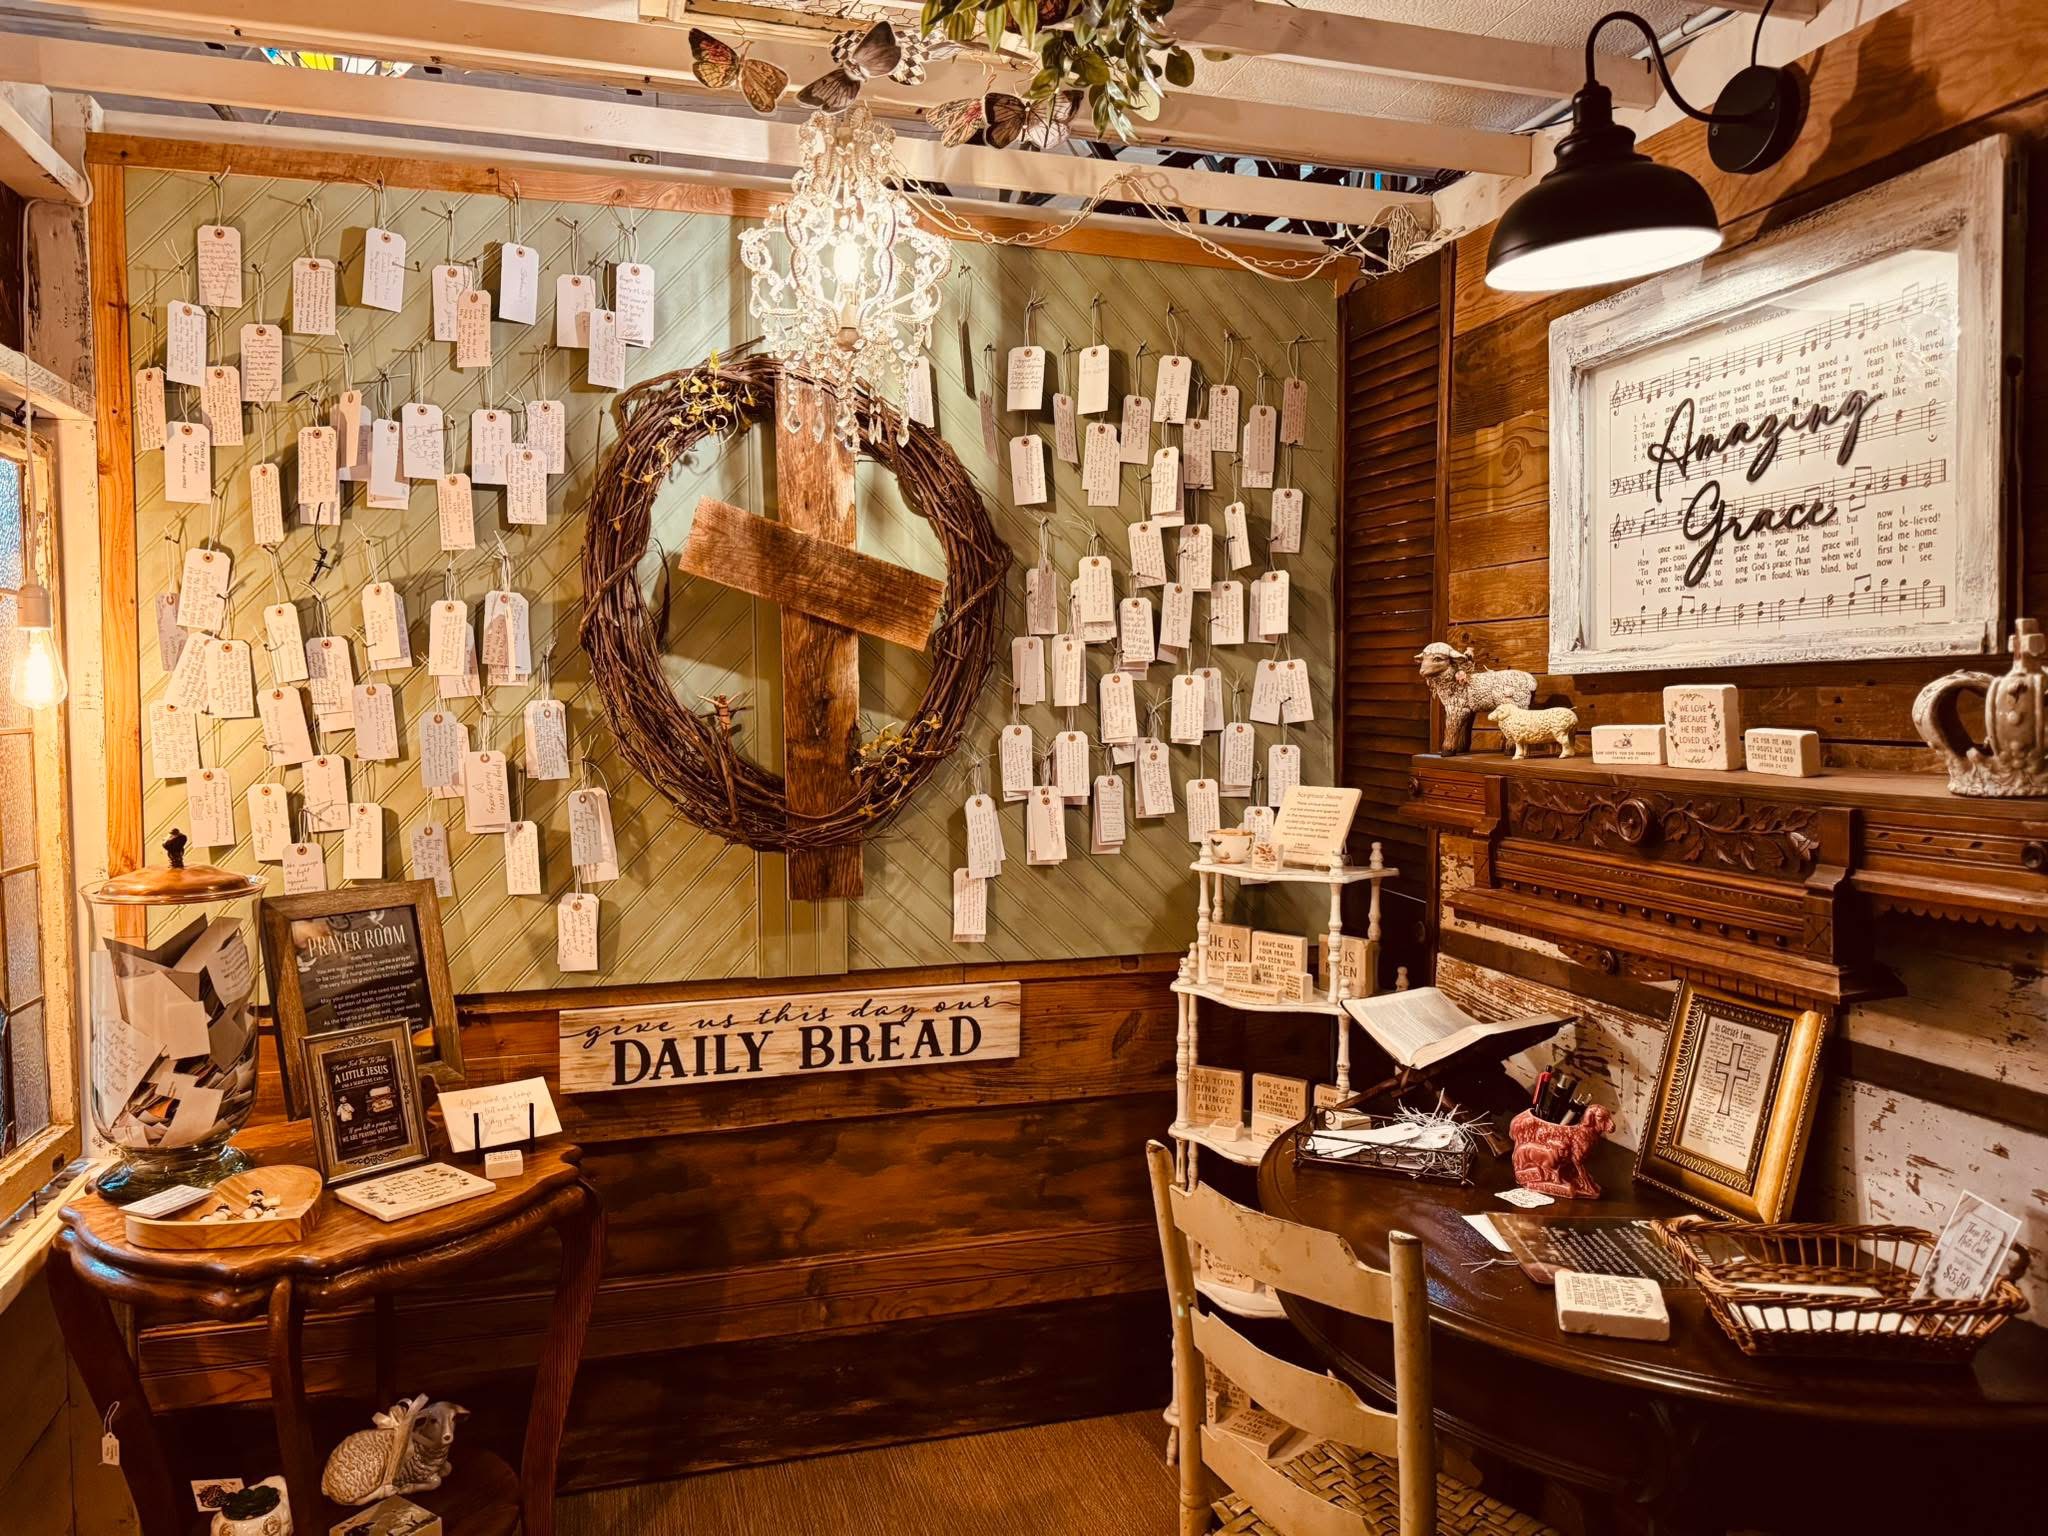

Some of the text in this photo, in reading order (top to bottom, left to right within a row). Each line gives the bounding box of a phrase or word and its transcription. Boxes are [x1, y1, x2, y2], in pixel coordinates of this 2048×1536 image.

[1718, 337, 1908, 398] how sweet the That saved wretch like
[1720, 400, 1730, 410] my
[1734, 395, 1750, 405] heart
[1797, 377, 1810, 386] And
[1818, 370, 1837, 383] grace
[1840, 365, 1852, 376] my
[1866, 356, 1885, 367] fears
[1892, 378, 1941, 397] like me!
[1893, 374, 1906, 384] the
[1735, 406, 1749, 415] toils
[1754, 400, 1766, 409] and
[1769, 395, 1789, 406] snares
[1819, 382, 1836, 392] have
[1647, 390, 1882, 504] Amazing
[1846, 515, 1858, 524] but
[1877, 510, 1892, 518] now
[1682, 480, 1838, 588] Grace
[1733, 544, 1750, 554] grace
[1775, 537, 1789, 547] pear
[1797, 534, 1809, 542] The
[1822, 530, 1839, 539] hour
[1877, 521, 1892, 531] first
[1657, 566, 1672, 576] grace
[1735, 555, 1748, 563] safe
[1796, 545, 1810, 554] And
[1822, 541, 1840, 552] grace
[1845, 538, 1859, 547] will
[1877, 534, 1893, 543] lead
[1635, 578, 1652, 586] We've
[1735, 566, 1748, 574] sing
[1752, 561, 1770, 571] God's
[1772, 561, 1792, 570] praise
[1822, 553, 1840, 562] when
[1843, 550, 1862, 559] we'd
[1877, 546, 1892, 555] first
[1755, 574, 1766, 582] I'm
[1796, 568, 1810, 576] Was
[1877, 558, 1893, 567] now
[308, 924, 406, 958] PRAYER ROOM
[1210, 934, 1240, 950] HE IS
[1274, 950, 1293, 958] PRAYER
[1345, 951, 1355, 963] IS
[560, 996, 1020, 1049] give us this day our
[1715, 1023, 1739, 1038] In Christ
[610, 1015, 981, 1086] DAILY BREAD
[335, 1065, 388, 1084] A LITTLE JESUS
[1212, 1078, 1235, 1086] YOUR
[1194, 1084, 1218, 1093] MIND
[1283, 1085, 1299, 1094] ABLE
[1198, 1094, 1232, 1104] THINGS
[1258, 1099, 1298, 1110] ABUNDANTLY
[1198, 1104, 1230, 1113] ABOVE
[1259, 1105, 1283, 1113] BEYOND
[359, 1129, 376, 1138] PRAYING
[1213, 1261, 1231, 1270] LOVED
[1943, 1264, 1970, 1290] $5.50
